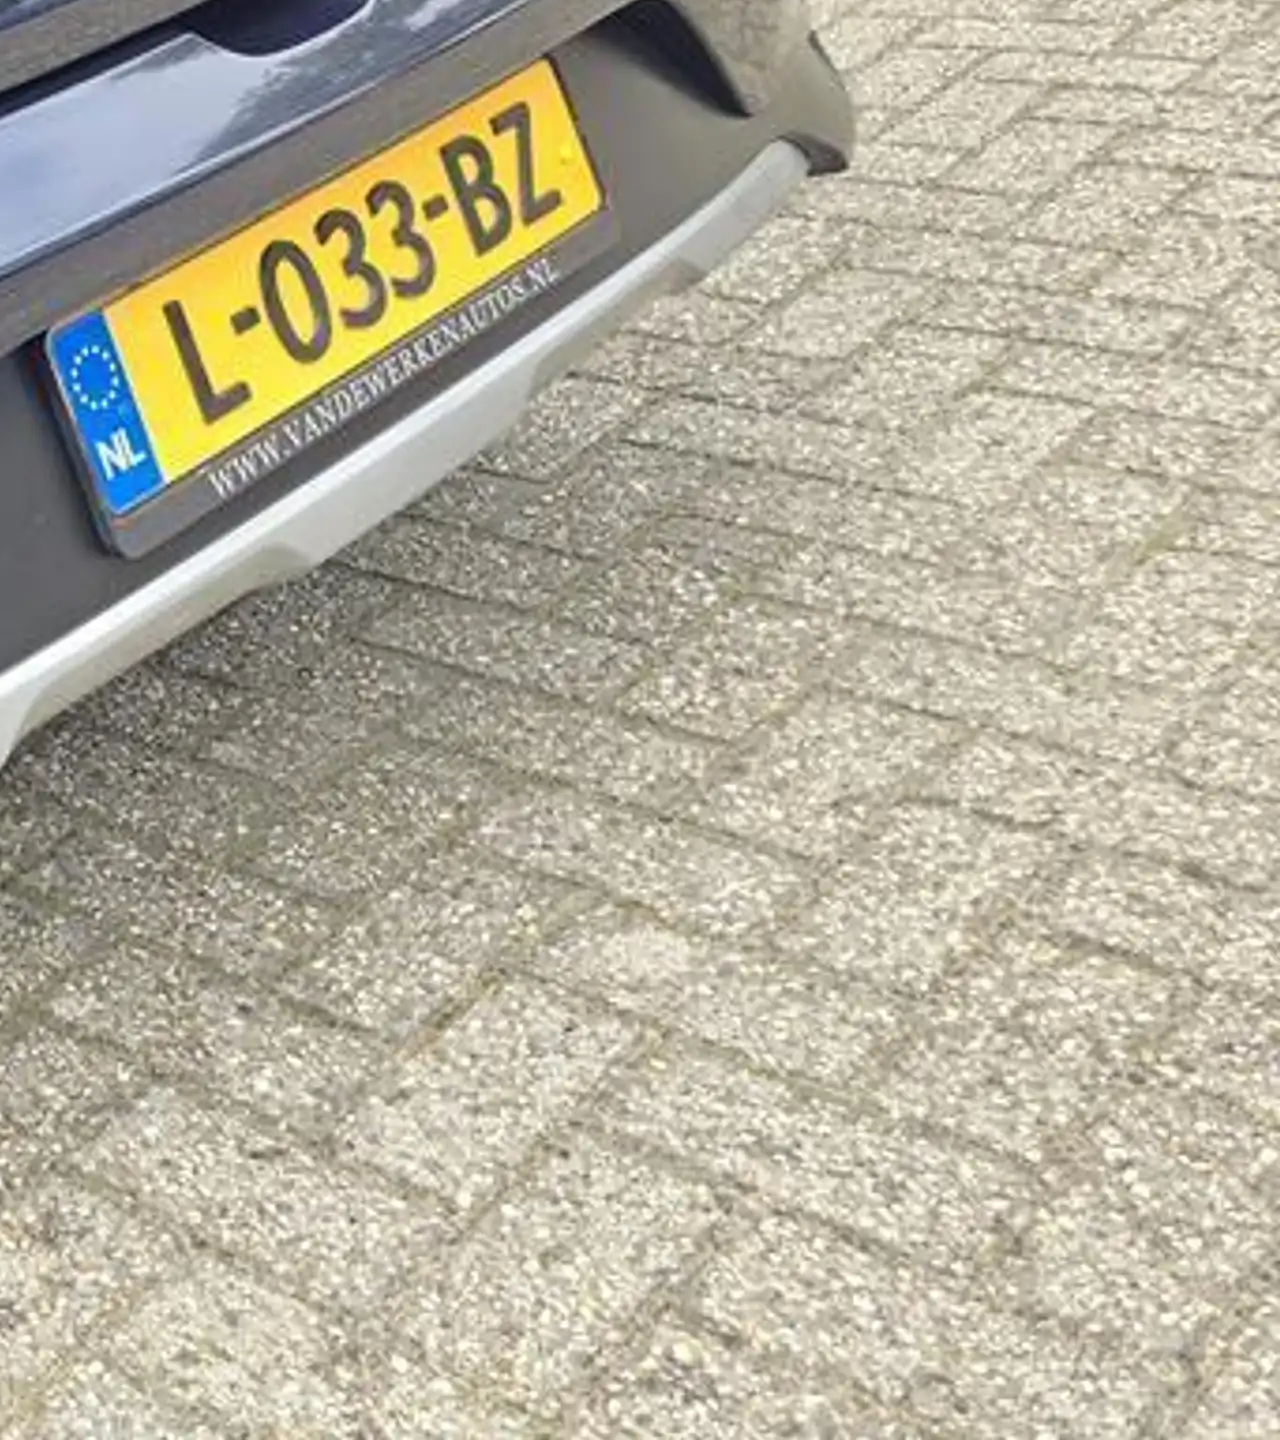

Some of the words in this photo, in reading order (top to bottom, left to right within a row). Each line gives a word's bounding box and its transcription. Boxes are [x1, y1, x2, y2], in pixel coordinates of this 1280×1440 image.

[161, 101, 562, 425] L-033-BZ
[206, 256, 562, 500] WWW.VANDEWERKENAUTOS.NL
[95, 427, 146, 481] NL
